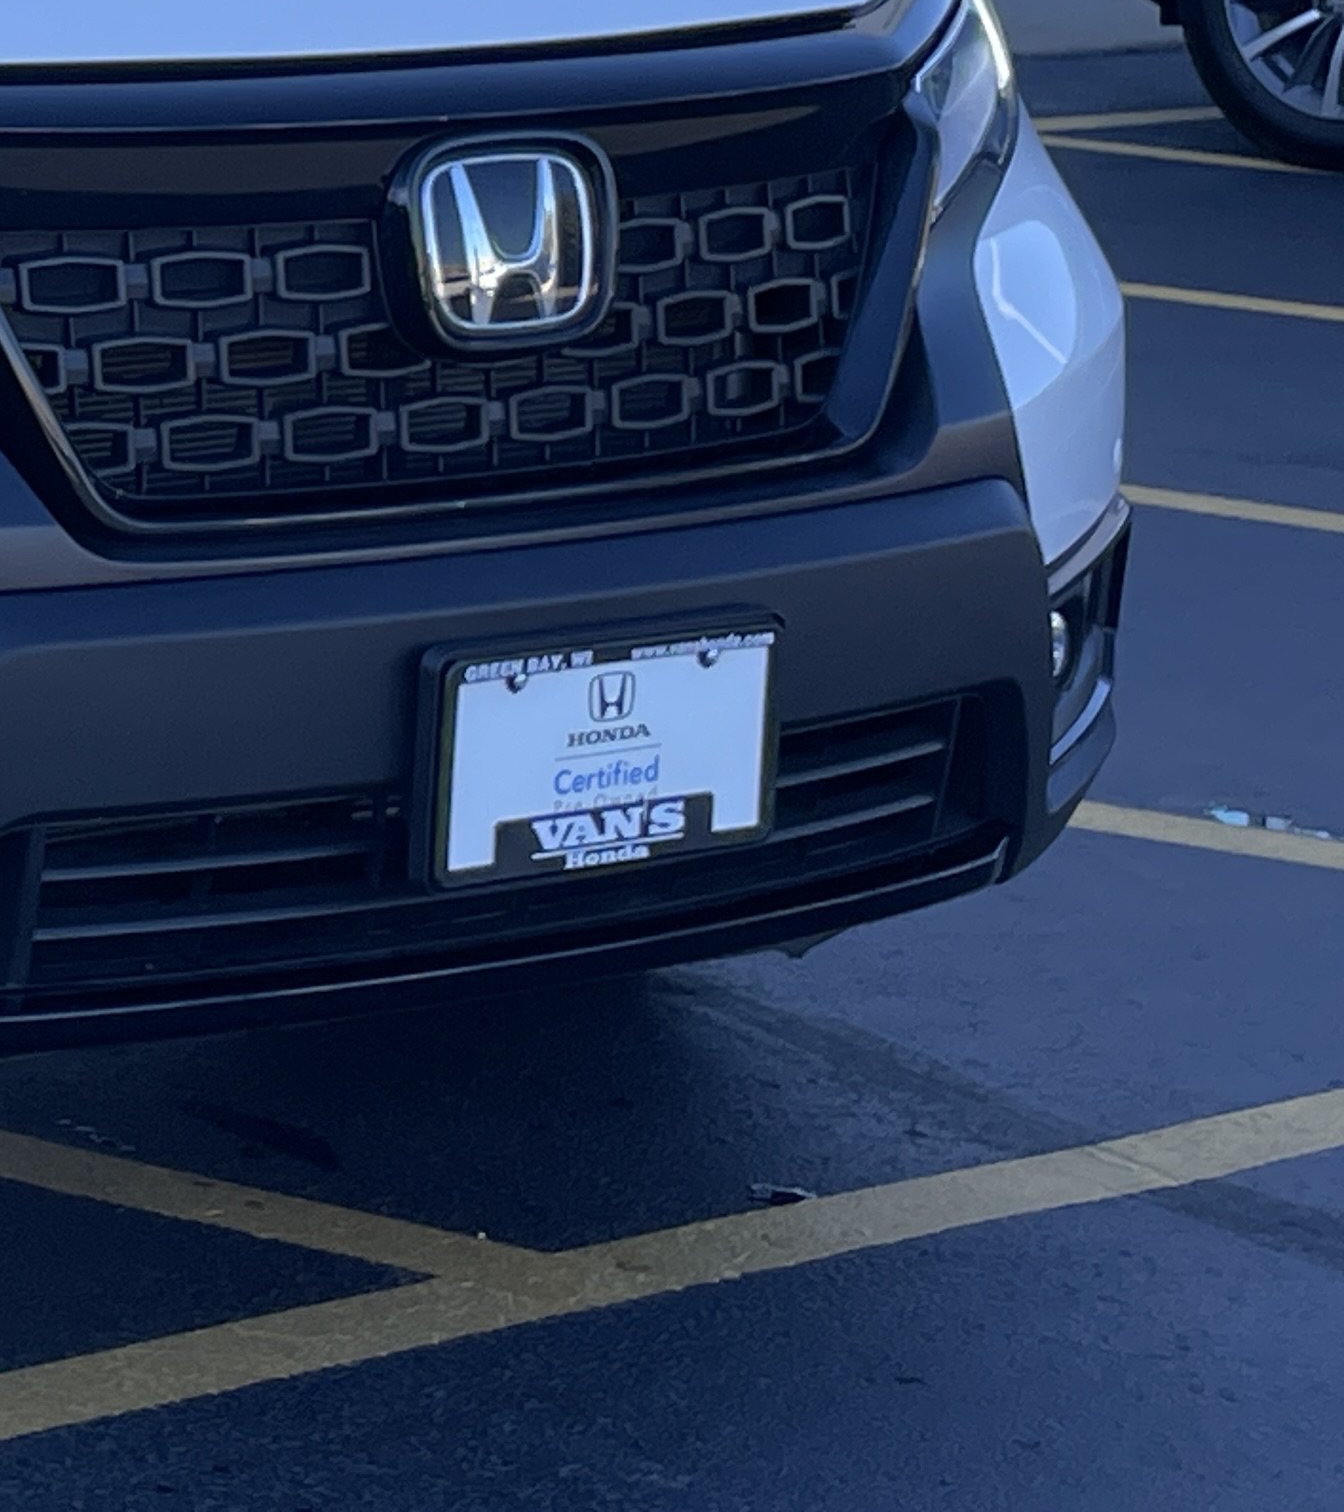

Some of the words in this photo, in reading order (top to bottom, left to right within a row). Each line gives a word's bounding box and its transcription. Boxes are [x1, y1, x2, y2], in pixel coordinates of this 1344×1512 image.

[463, 659, 525, 683] GREEN
[566, 722, 652, 748] HONDA
[553, 754, 661, 796] Certified
[563, 844, 651, 870] Honda
